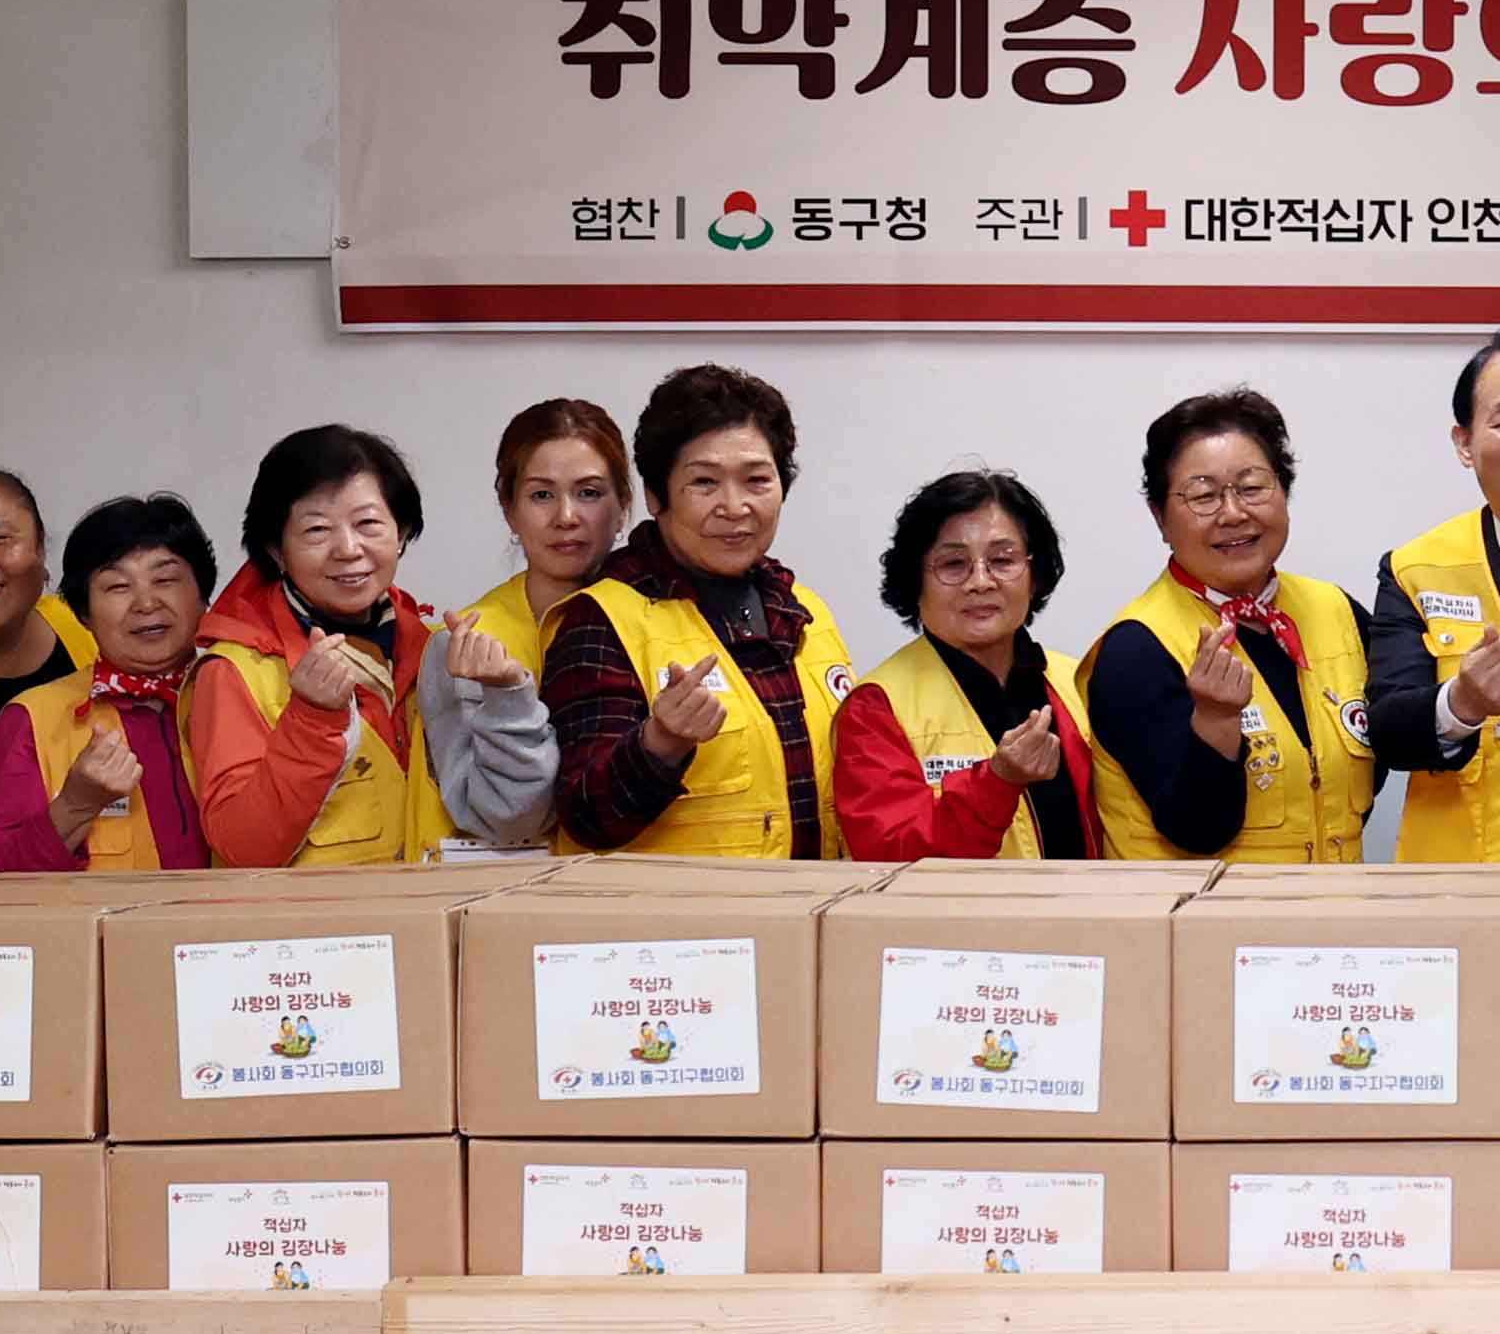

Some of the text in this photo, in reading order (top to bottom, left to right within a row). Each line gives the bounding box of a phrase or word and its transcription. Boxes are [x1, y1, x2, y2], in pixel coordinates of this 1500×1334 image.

[571, 196, 661, 242] 협찬
[791, 196, 928, 242] 동구청
[975, 197, 1064, 242] 주관
[1184, 196, 1413, 243] 대한적십자
[267, 970, 313, 989] 적십자
[230, 990, 353, 1014] 사랑의 김장나눔
[974, 984, 1021, 1001] 적십자
[934, 1004, 1059, 1027] 사랑의 김장나눔
[230, 1058, 385, 1084] 봉사회 동구지구협의회
[929, 1075, 1085, 1096] 봉사회 동구지구협의회
[618, 1202, 664, 1218] 적십자
[1321, 1208, 1367, 1225] 적십자
[579, 1223, 704, 1242] 사랑의 김장나눔
[1282, 1230, 1407, 1249] 사랑의 김장나눔
